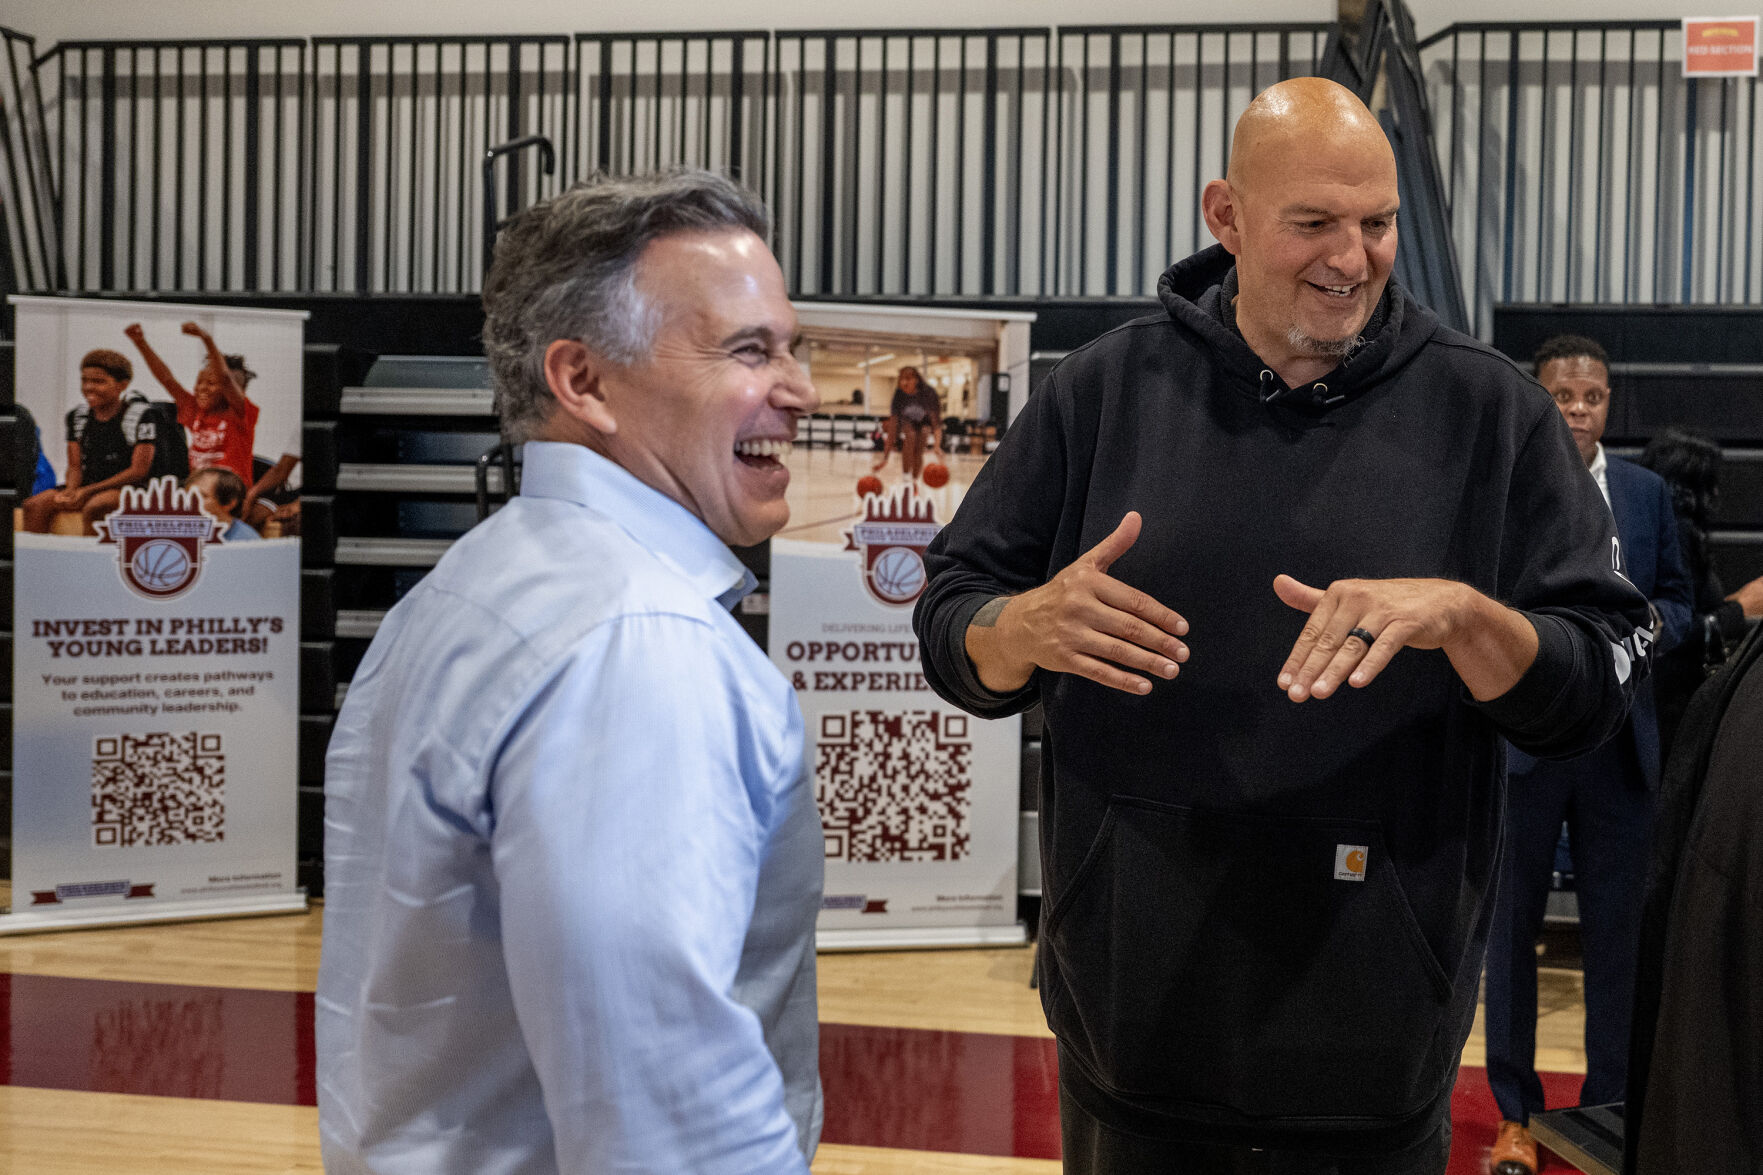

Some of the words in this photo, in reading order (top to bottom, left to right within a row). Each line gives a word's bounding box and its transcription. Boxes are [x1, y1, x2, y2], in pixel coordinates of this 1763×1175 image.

[1710, 44, 1753, 56] SECTION
[32, 619, 129, 637] INVEST
[135, 619, 163, 635] IN
[169, 616, 284, 634] PHILLY'S
[821, 623, 886, 634] DELIVERING
[47, 639, 143, 657] YOUNG
[149, 637, 269, 656] LEADERS!
[786, 641, 921, 662] OPPORTU
[41, 673, 78, 686] Your
[82, 672, 141, 687] support
[145, 671, 199, 684] creates
[203, 669, 275, 684] pathways
[792, 671, 808, 691] &
[61, 689, 77, 701] to
[80, 687, 160, 701] education,
[164, 685, 225, 699] careers,
[228, 685, 255, 697] and
[73, 703, 158, 717] community
[161, 700, 243, 715] leadership.
